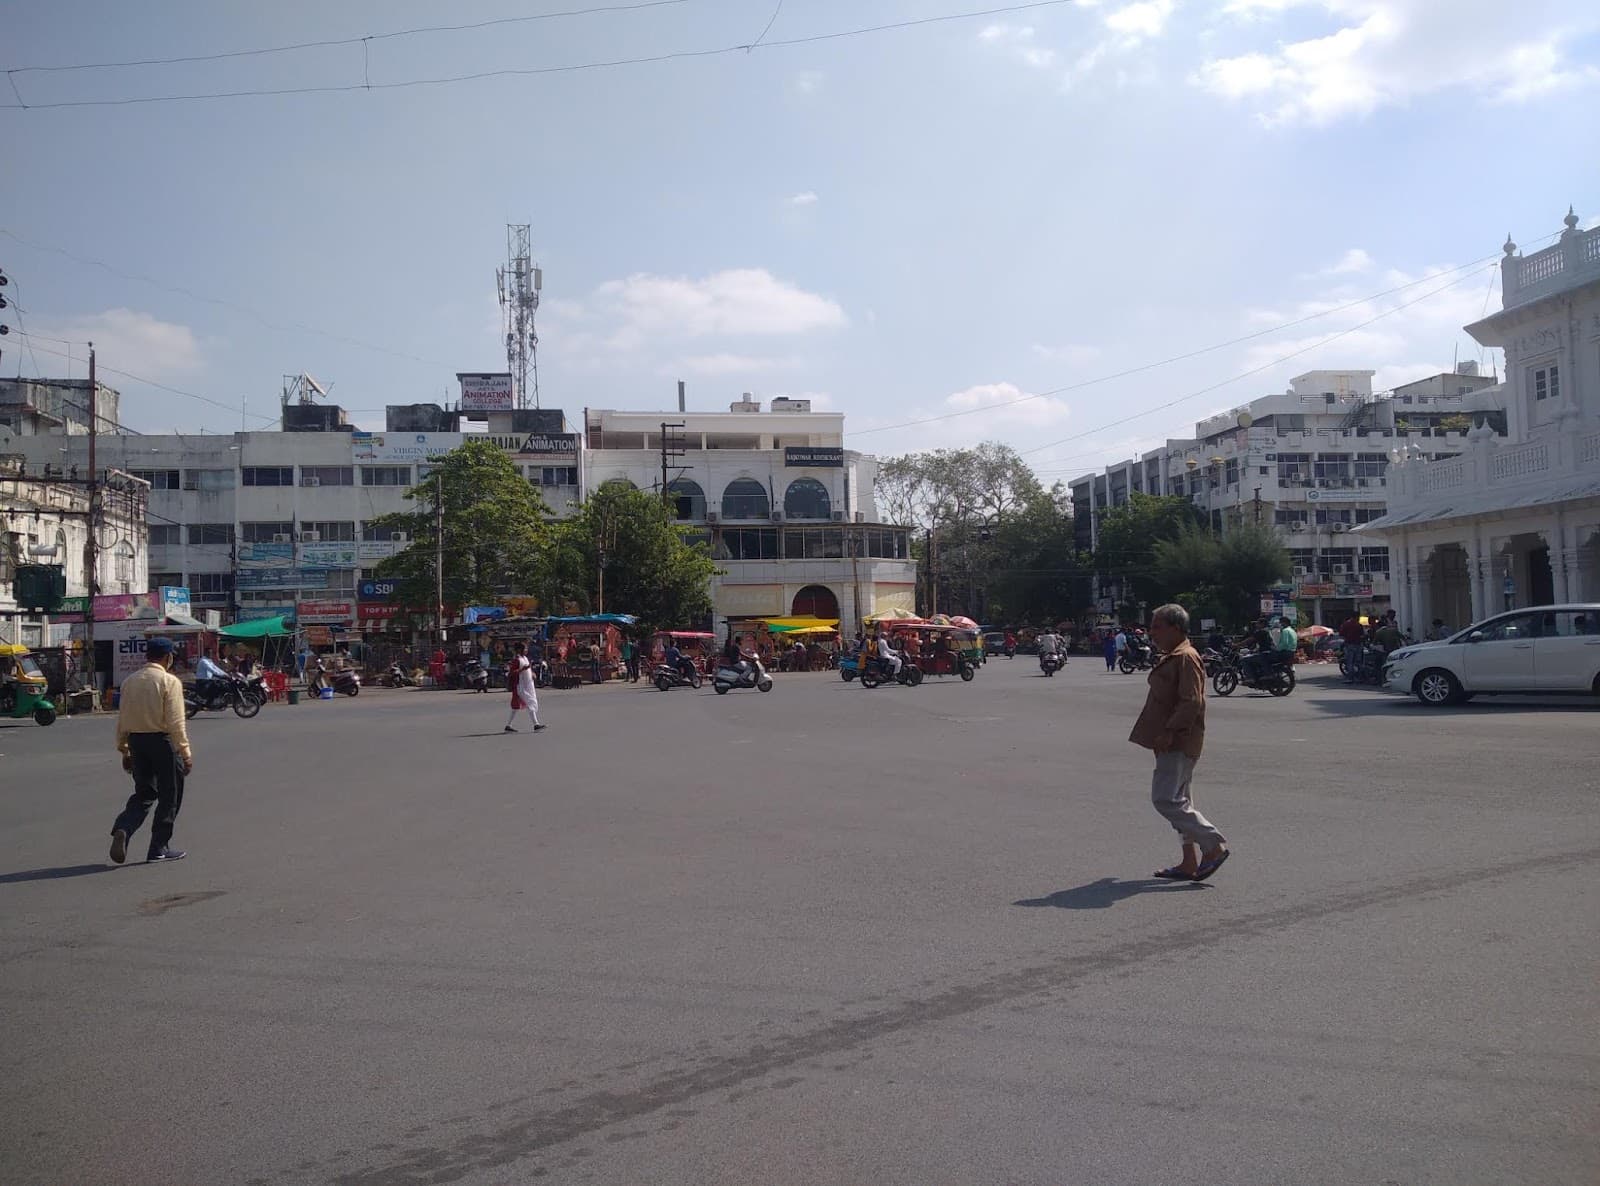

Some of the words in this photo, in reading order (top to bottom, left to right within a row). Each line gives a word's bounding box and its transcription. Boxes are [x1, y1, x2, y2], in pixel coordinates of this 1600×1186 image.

[463, 390, 511, 399] ANIMATION
[526, 439, 575, 450] ANIMATION
[375, 583, 394, 595] SBI
